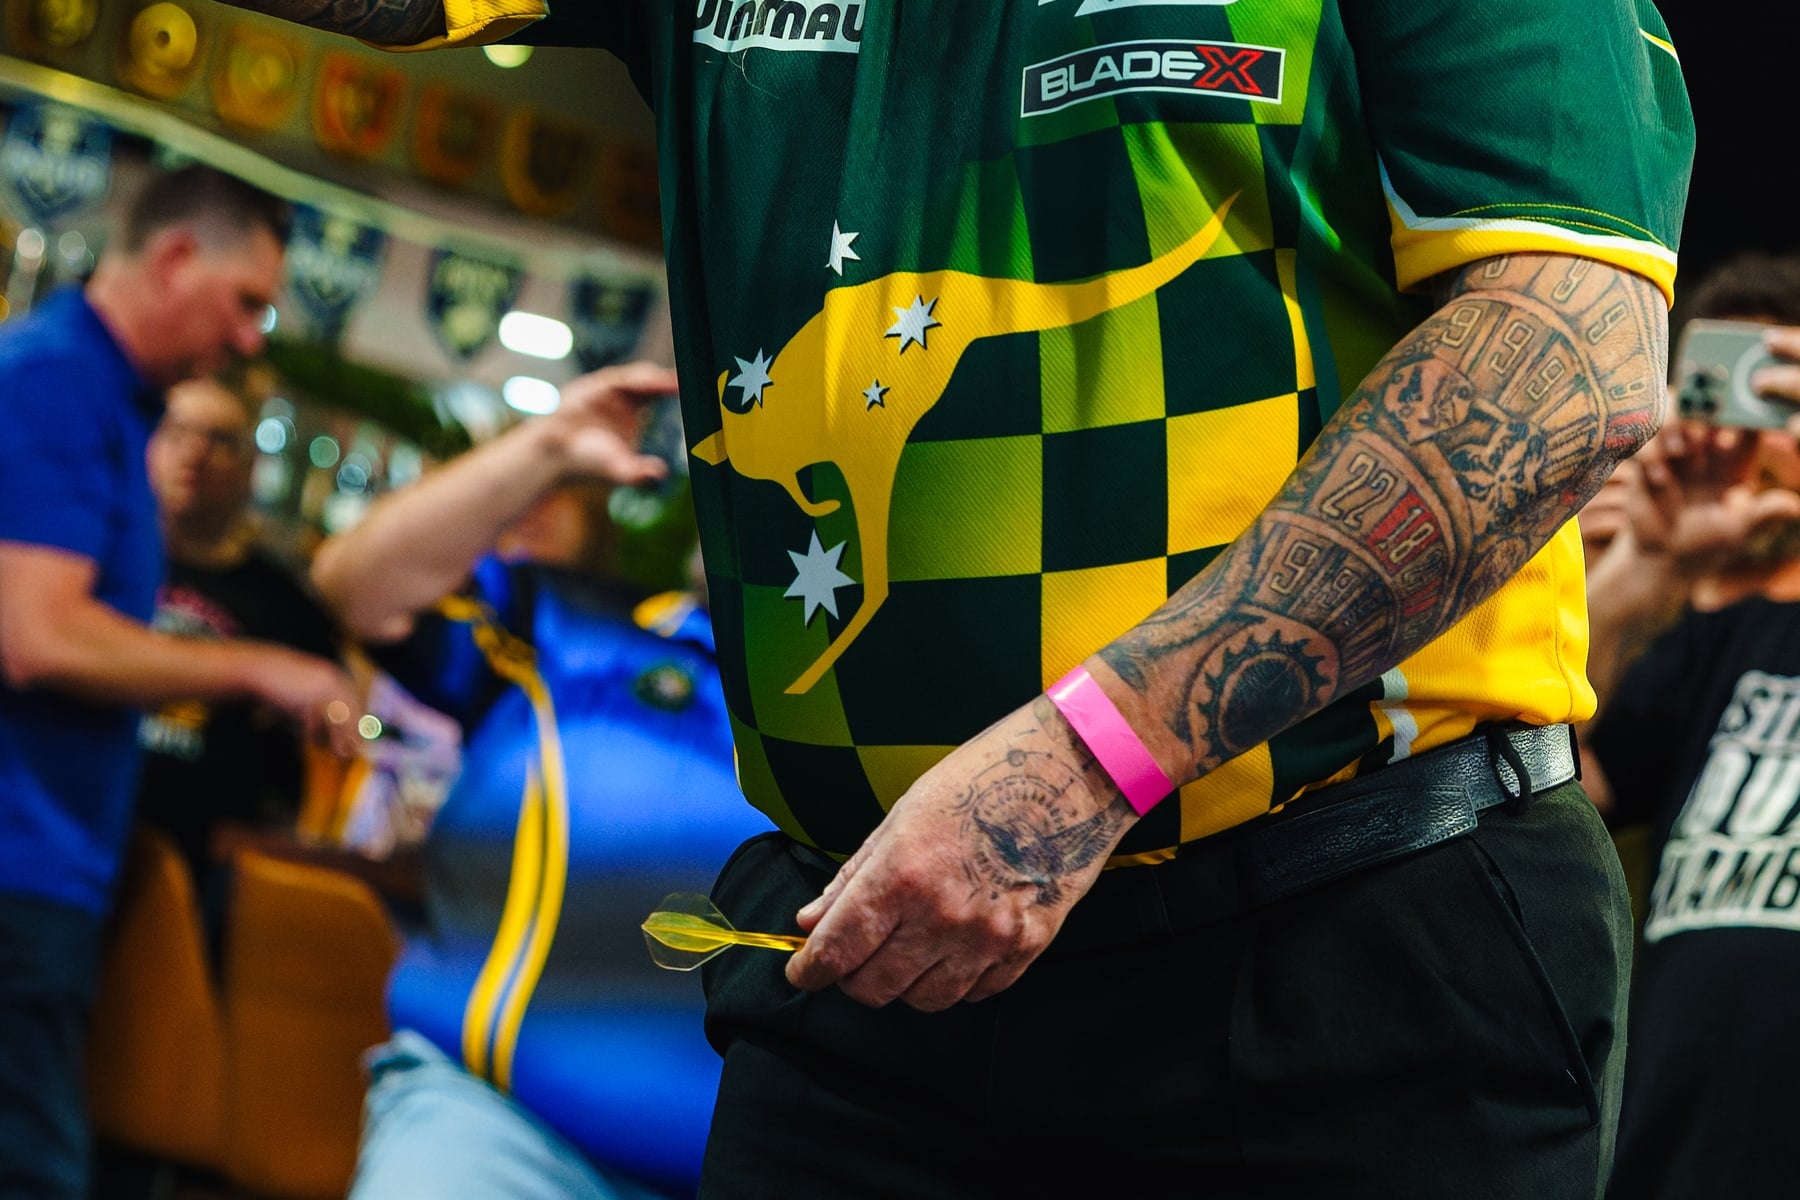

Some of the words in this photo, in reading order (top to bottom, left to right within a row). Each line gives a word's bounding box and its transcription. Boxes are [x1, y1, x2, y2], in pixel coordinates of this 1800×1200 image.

[1441, 305, 1484, 349] 9
[1490, 320, 1537, 377] 9
[1526, 357, 1566, 402] 9
[1319, 451, 1399, 531] 22
[1376, 505, 1436, 565] 18
[1270, 539, 1320, 596] 9
